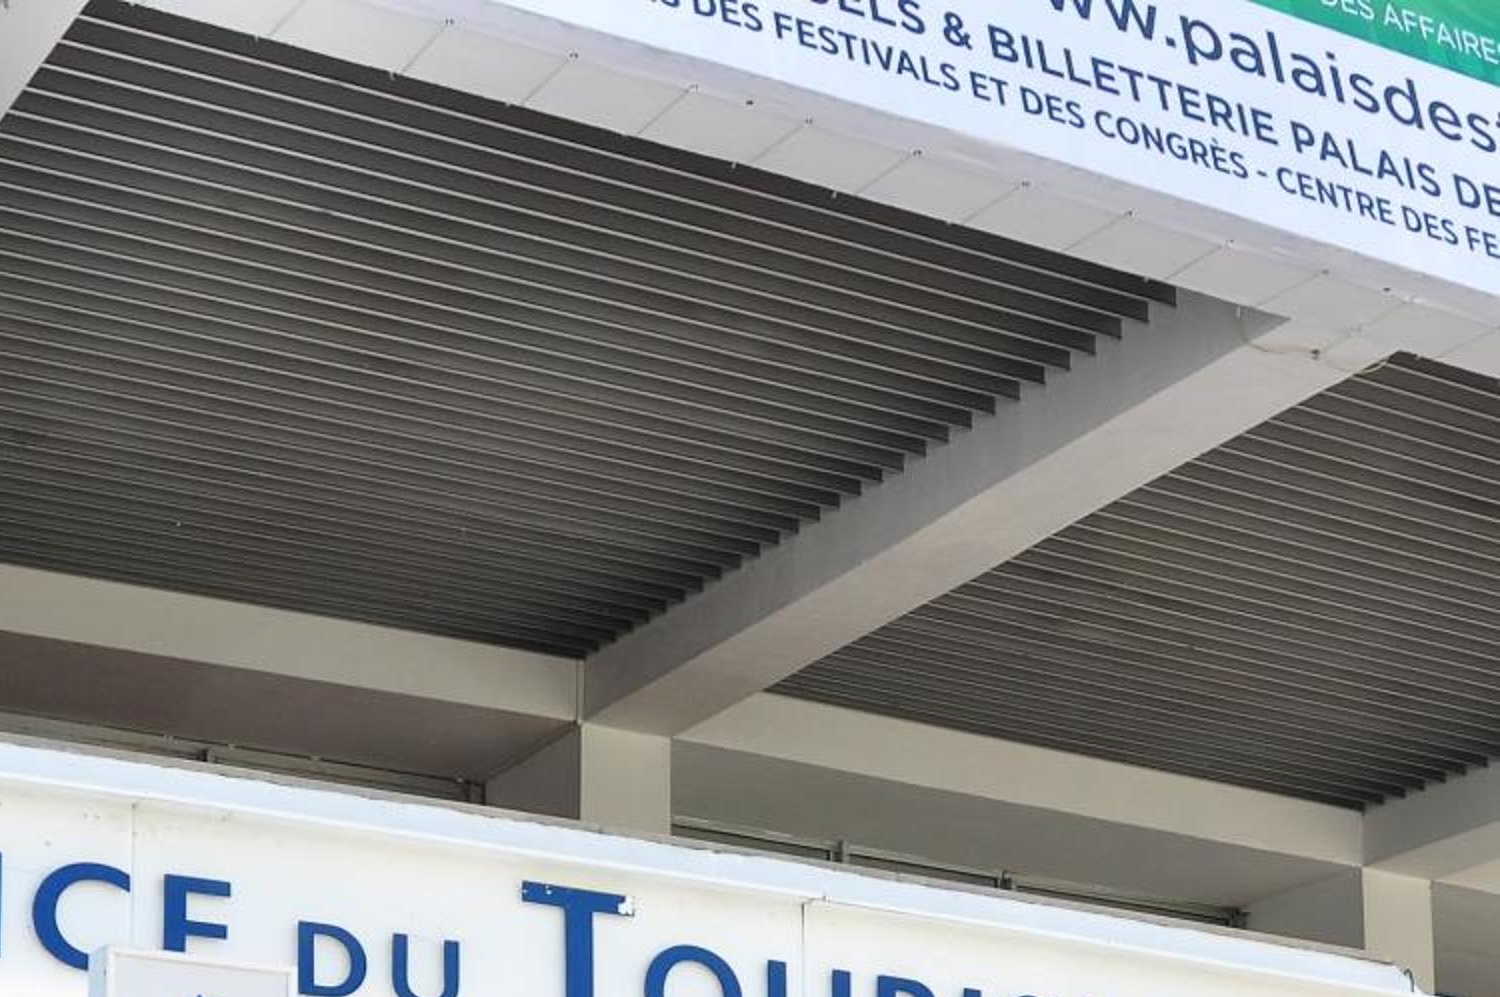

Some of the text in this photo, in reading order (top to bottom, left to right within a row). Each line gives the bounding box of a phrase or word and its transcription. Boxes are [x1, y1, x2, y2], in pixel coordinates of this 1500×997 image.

[943, 11, 973, 50] &
[988, 22, 1279, 147] BILLETTERIE
[1290, 120, 1442, 198] PALAIS
[1384, 4, 1500, 65] AFFAIRE
[773, 11, 961, 91] FESTIVALS
[969, 70, 1008, 104] ET
[1019, 87, 1085, 129] DES
[1094, 107, 1249, 180] CONGRÈS
[1277, 166, 1395, 227] CENTRE
[1401, 205, 1459, 246] DES
